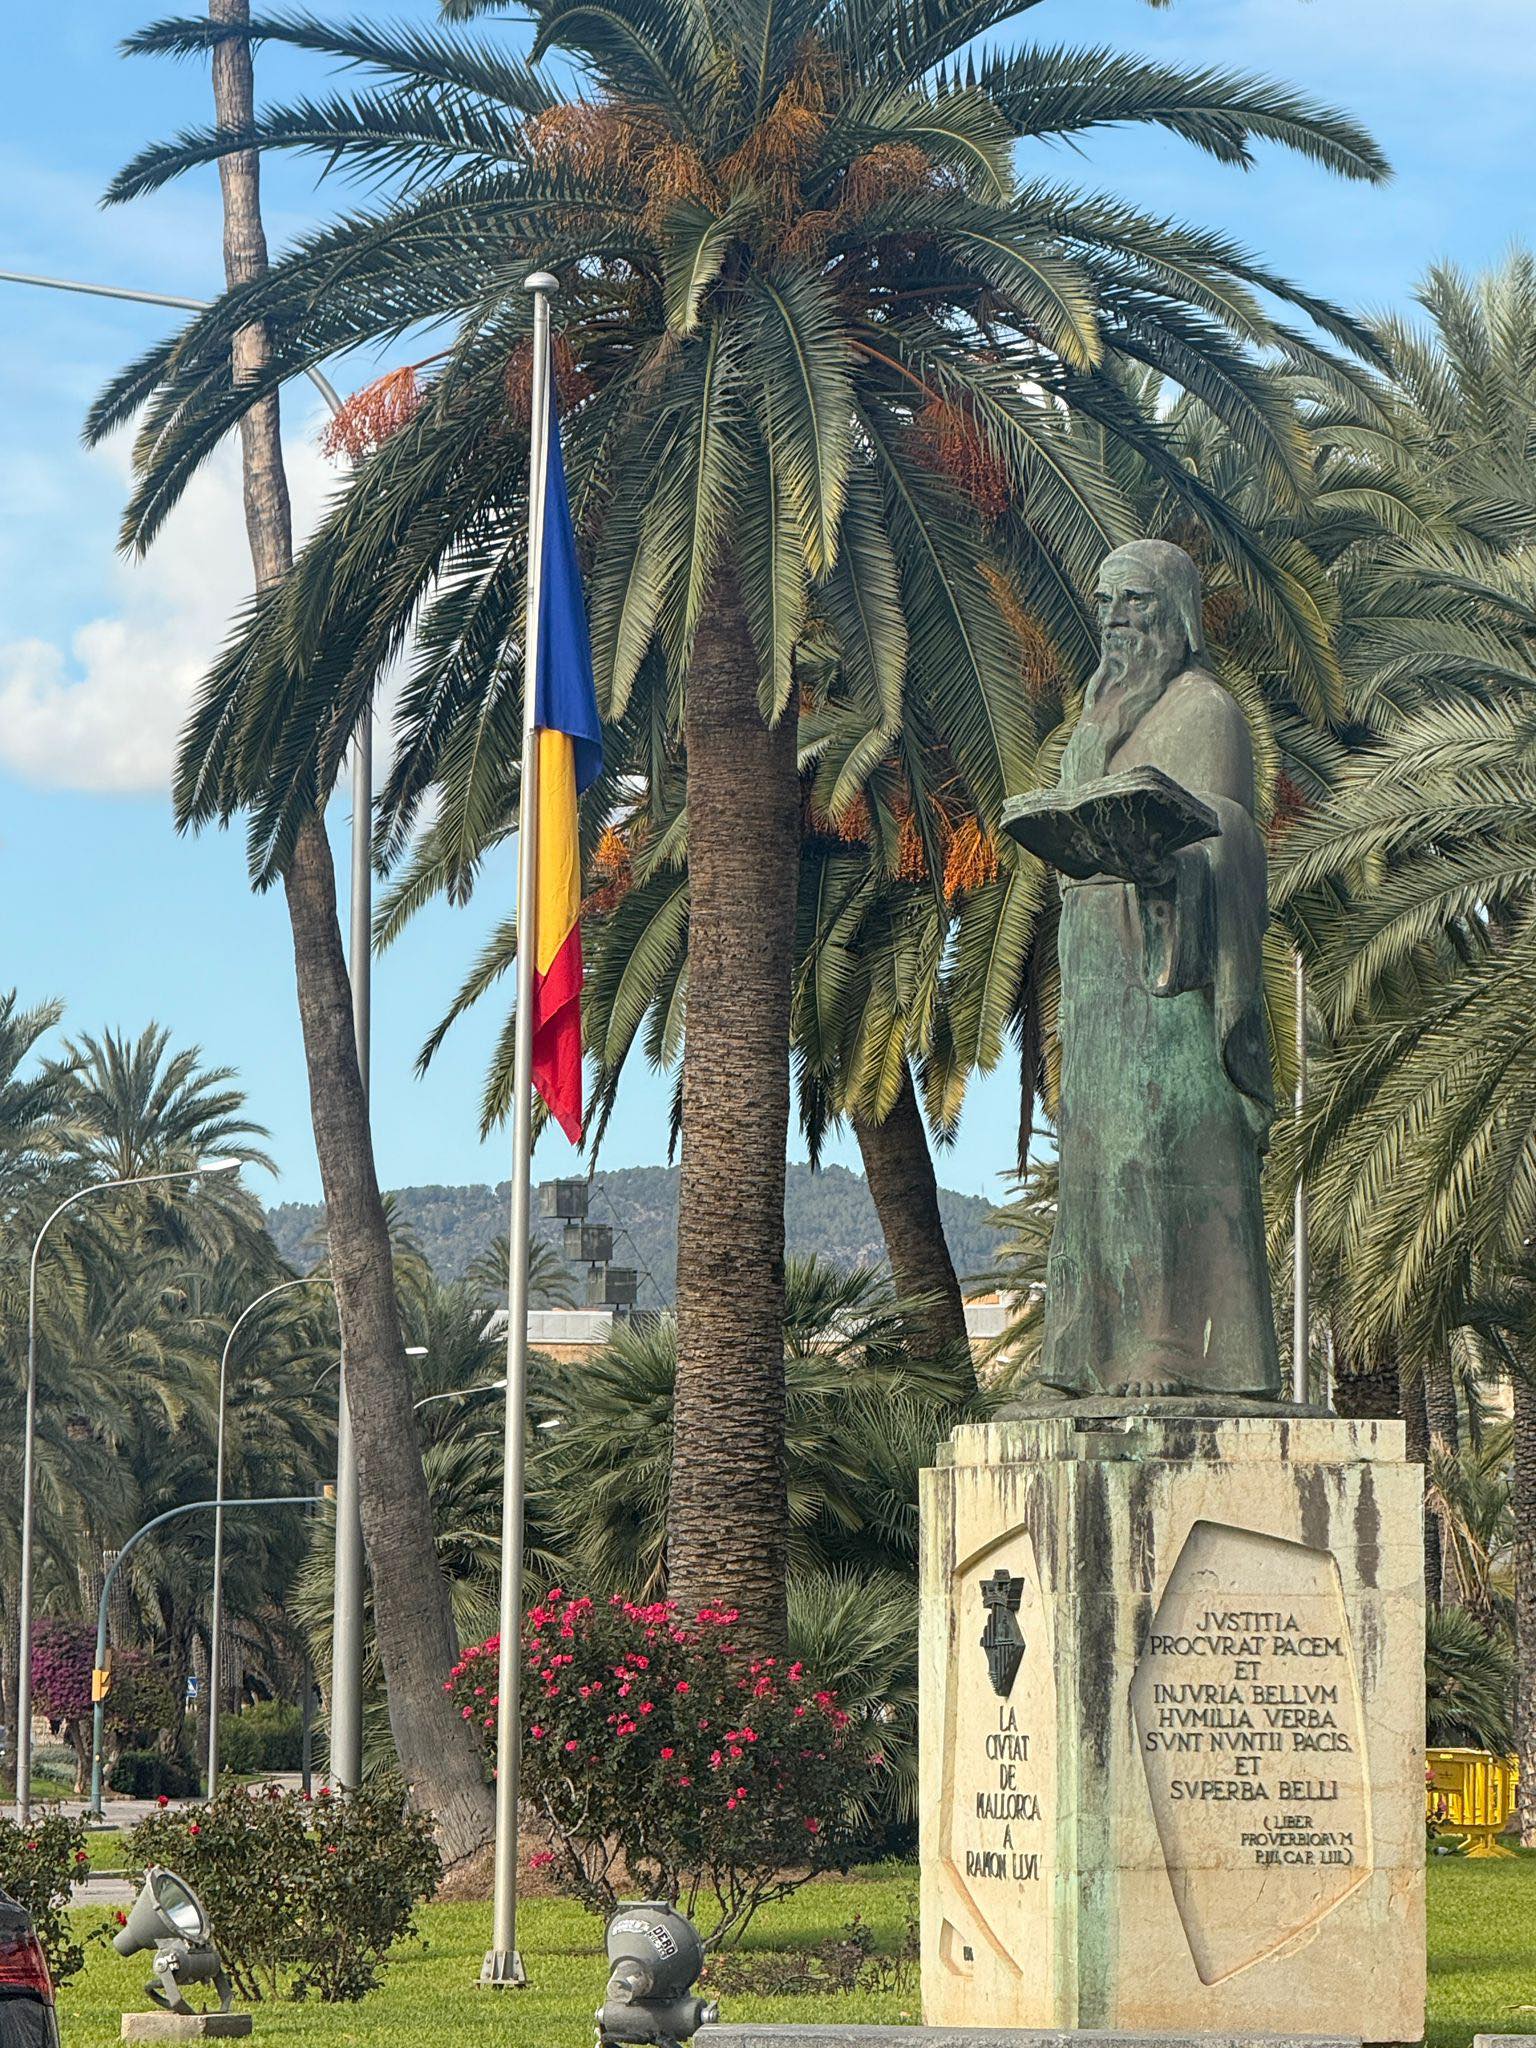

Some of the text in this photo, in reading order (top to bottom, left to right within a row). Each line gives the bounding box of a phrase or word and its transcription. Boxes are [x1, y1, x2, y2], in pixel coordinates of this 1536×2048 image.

[1197, 1612, 1300, 1632] JVSTITIA
[1150, 1636, 1265, 1656] PROCVRAT
[1234, 1661, 1261, 1680] ET
[1154, 1684, 1338, 1705] INJVRIA BELLVM
[999, 1705, 1018, 1732] LA
[1158, 1708, 1337, 1728] HVMILIA VERBA
[1146, 1732, 1204, 1751] SVNT
[1210, 1732, 1283, 1751] NVNTII
[1234, 1756, 1262, 1775] ET
[1000, 1763, 1017, 1791] DE
[1170, 1781, 1338, 1800] SVPERBA BELLI
[976, 1792, 1042, 1820] MALLORCA
[1003, 1823, 1014, 1850] A
[966, 1851, 1007, 1880] RAMON
